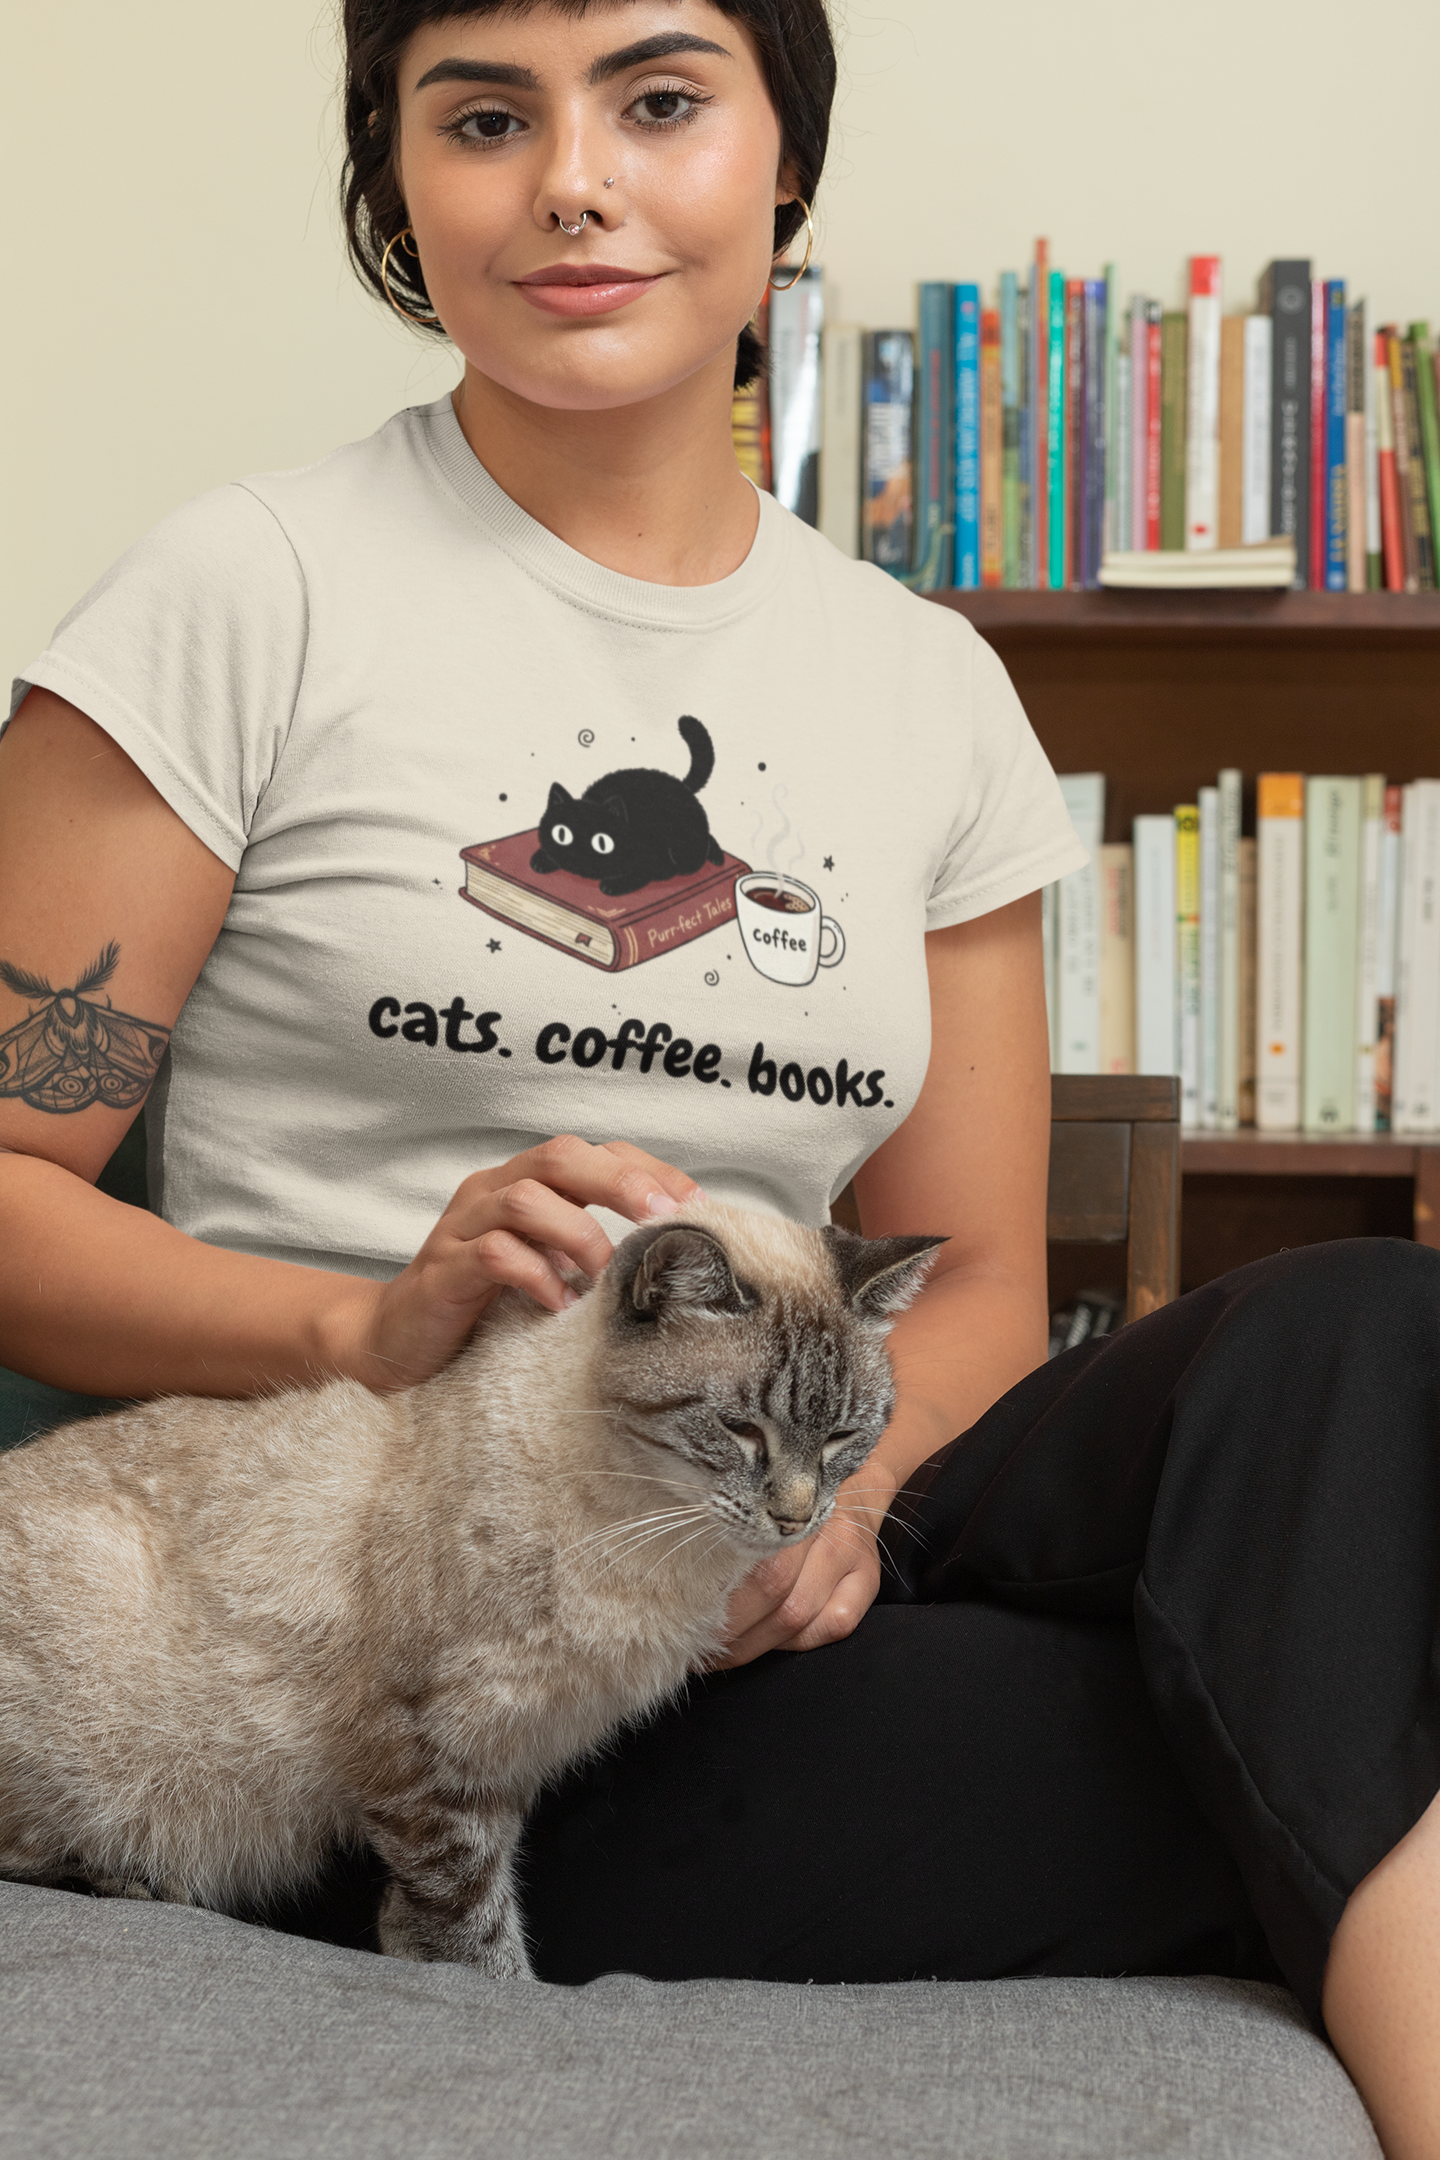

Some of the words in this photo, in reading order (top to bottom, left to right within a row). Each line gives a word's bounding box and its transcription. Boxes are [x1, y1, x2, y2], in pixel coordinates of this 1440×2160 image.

[647, 909, 702, 948] Purr-fect
[703, 896, 733, 920] Tales
[367, 995, 513, 1059] cats.
[534, 1018, 732, 1089] coffee.
[746, 1041, 895, 1109] books.
